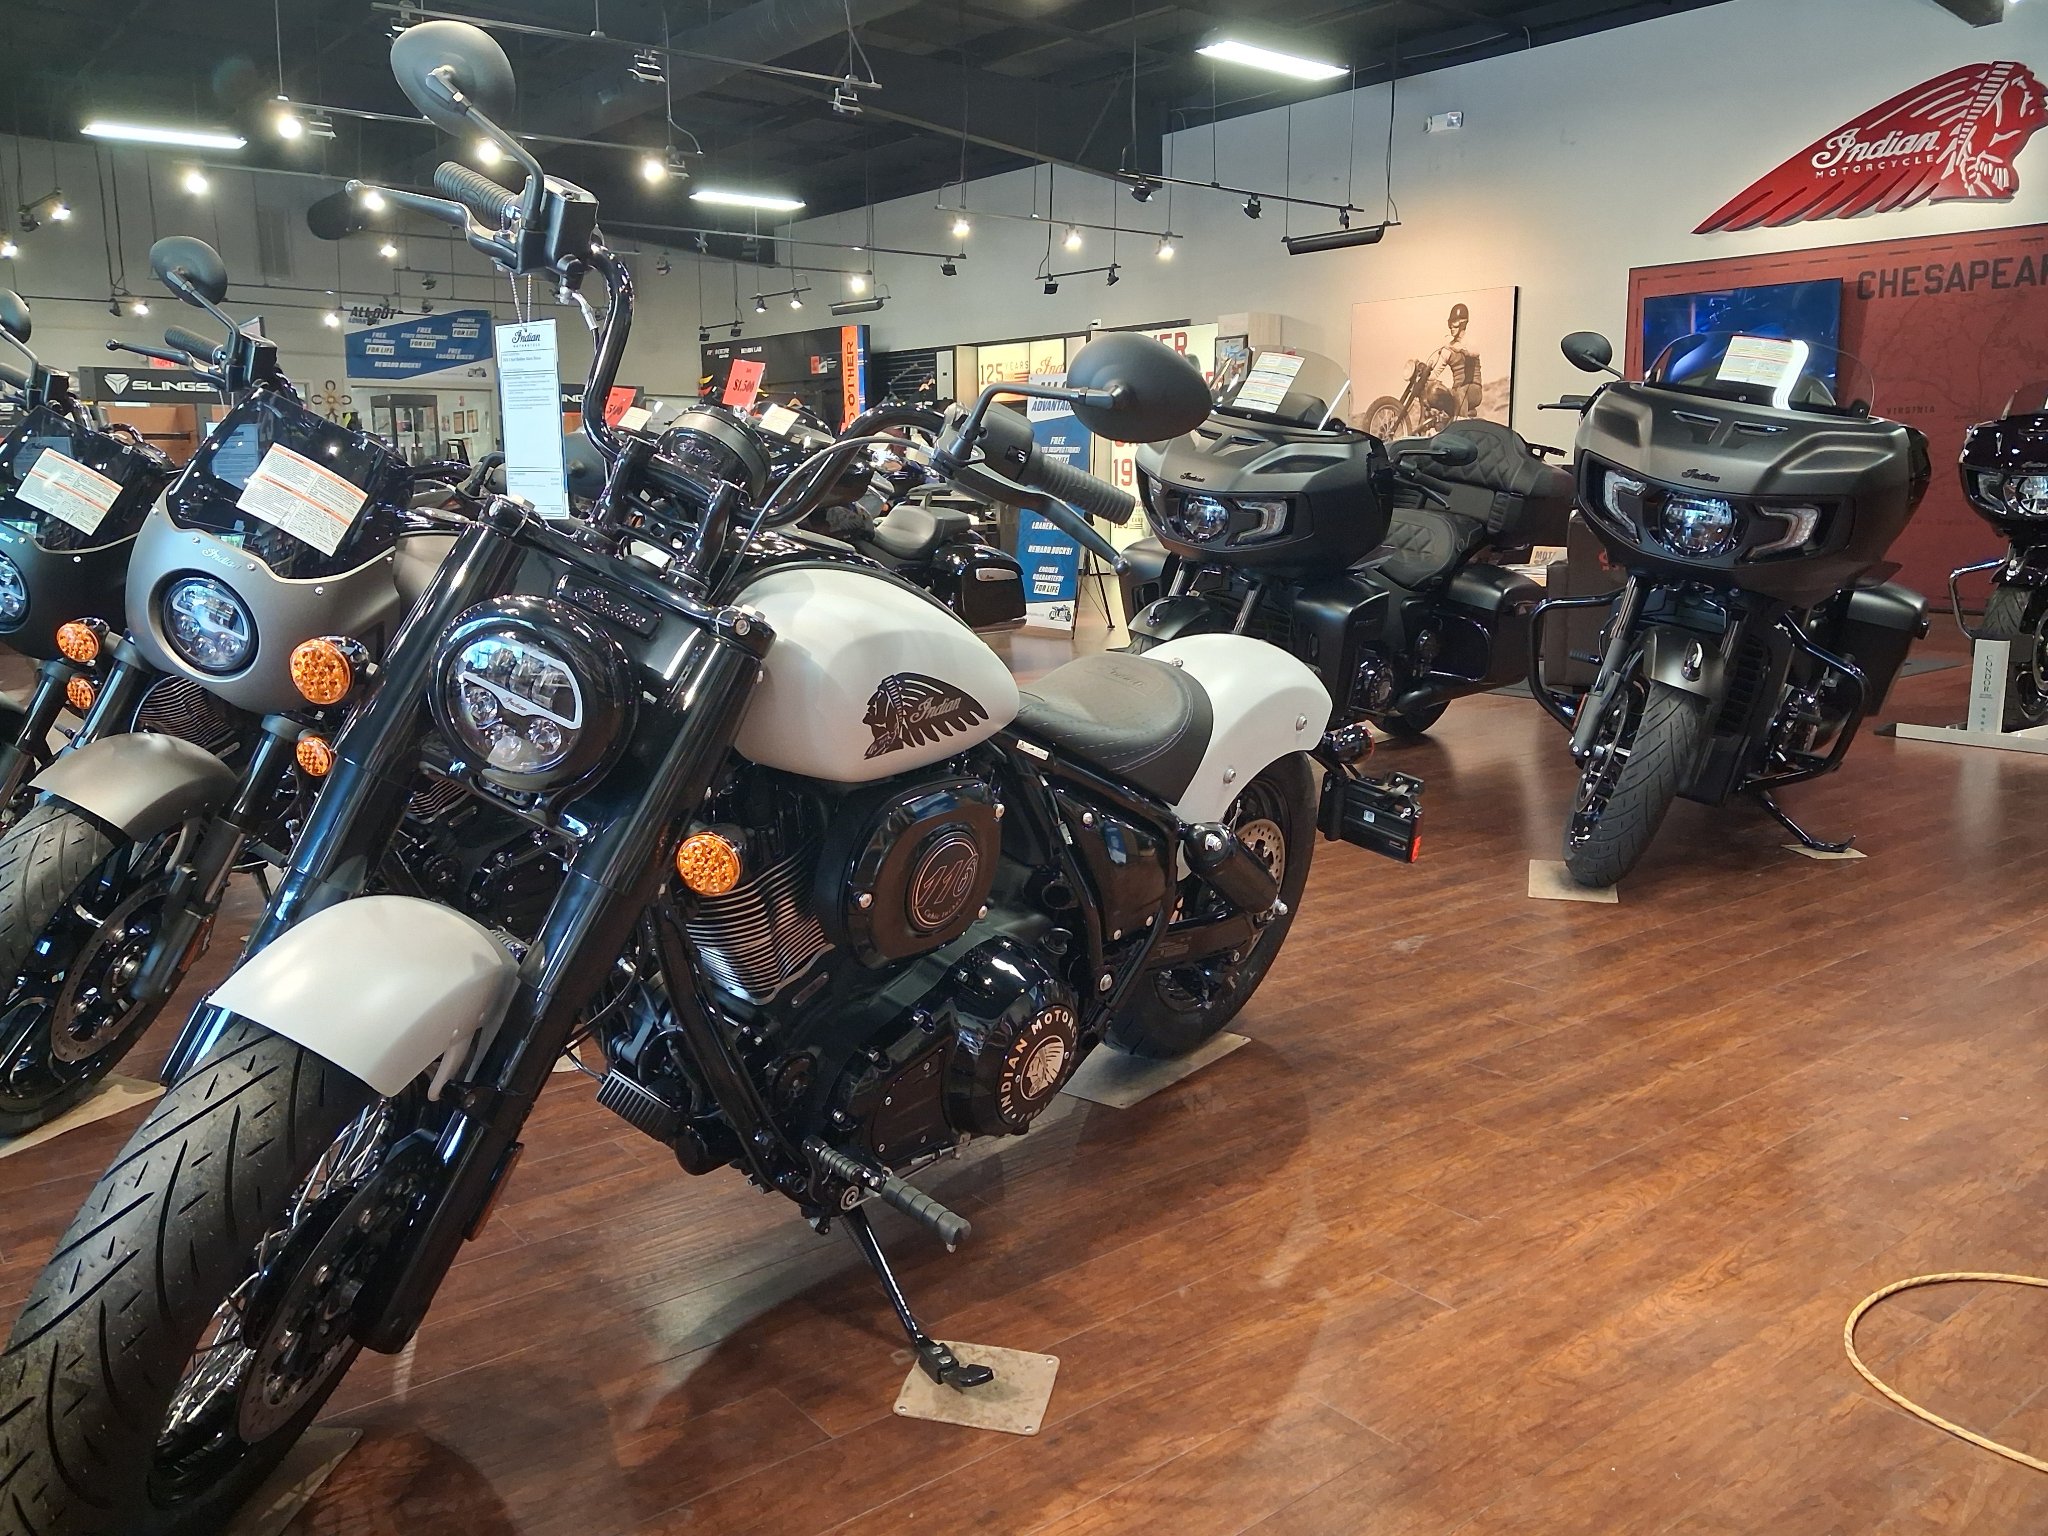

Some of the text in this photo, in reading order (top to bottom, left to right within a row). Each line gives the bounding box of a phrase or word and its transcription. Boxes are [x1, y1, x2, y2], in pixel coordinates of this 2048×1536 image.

[1811, 126, 1941, 169] Indian
[1815, 154, 1934, 179] MOTORCYCLE
[512, 330, 540, 343] Indian
[846, 341, 856, 406] OTHER
[980, 362, 1004, 385] 125
[131, 380, 214, 392] SLINGS
[1031, 400, 1073, 412] ADVANTAG
[1886, 405, 1935, 415] VIRGINIA
[1050, 436, 1066, 445] FREE
[1113, 459, 1133, 487] 19
[1035, 584, 1059, 593] FOR LIFE
[909, 696, 961, 723] Indian
[915, 853, 979, 908] 116
[1001, 1009, 1077, 1115] INDIAN MOTORC
